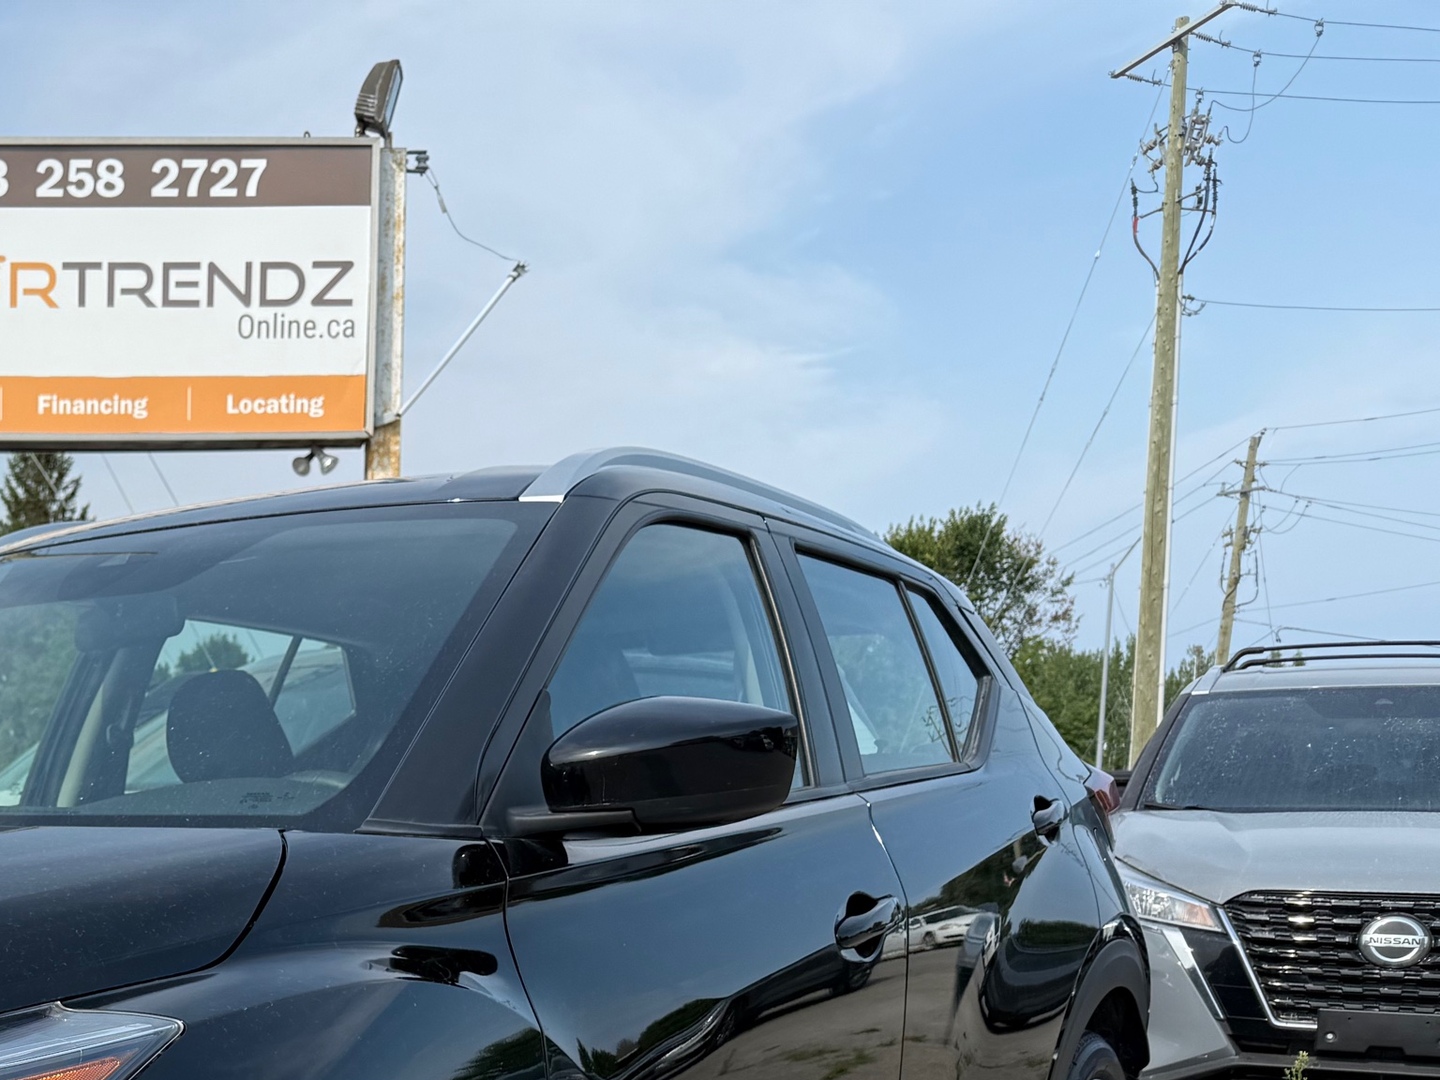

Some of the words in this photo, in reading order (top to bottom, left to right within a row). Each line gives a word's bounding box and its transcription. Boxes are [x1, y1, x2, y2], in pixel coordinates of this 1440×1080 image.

[35, 158, 125, 198] 258
[151, 158, 267, 198] 2727
[237, 313, 356, 340] Online.ca
[37, 393, 148, 419] Financing
[226, 393, 324, 418] Locating
[1368, 936, 1421, 946] NISSAN
